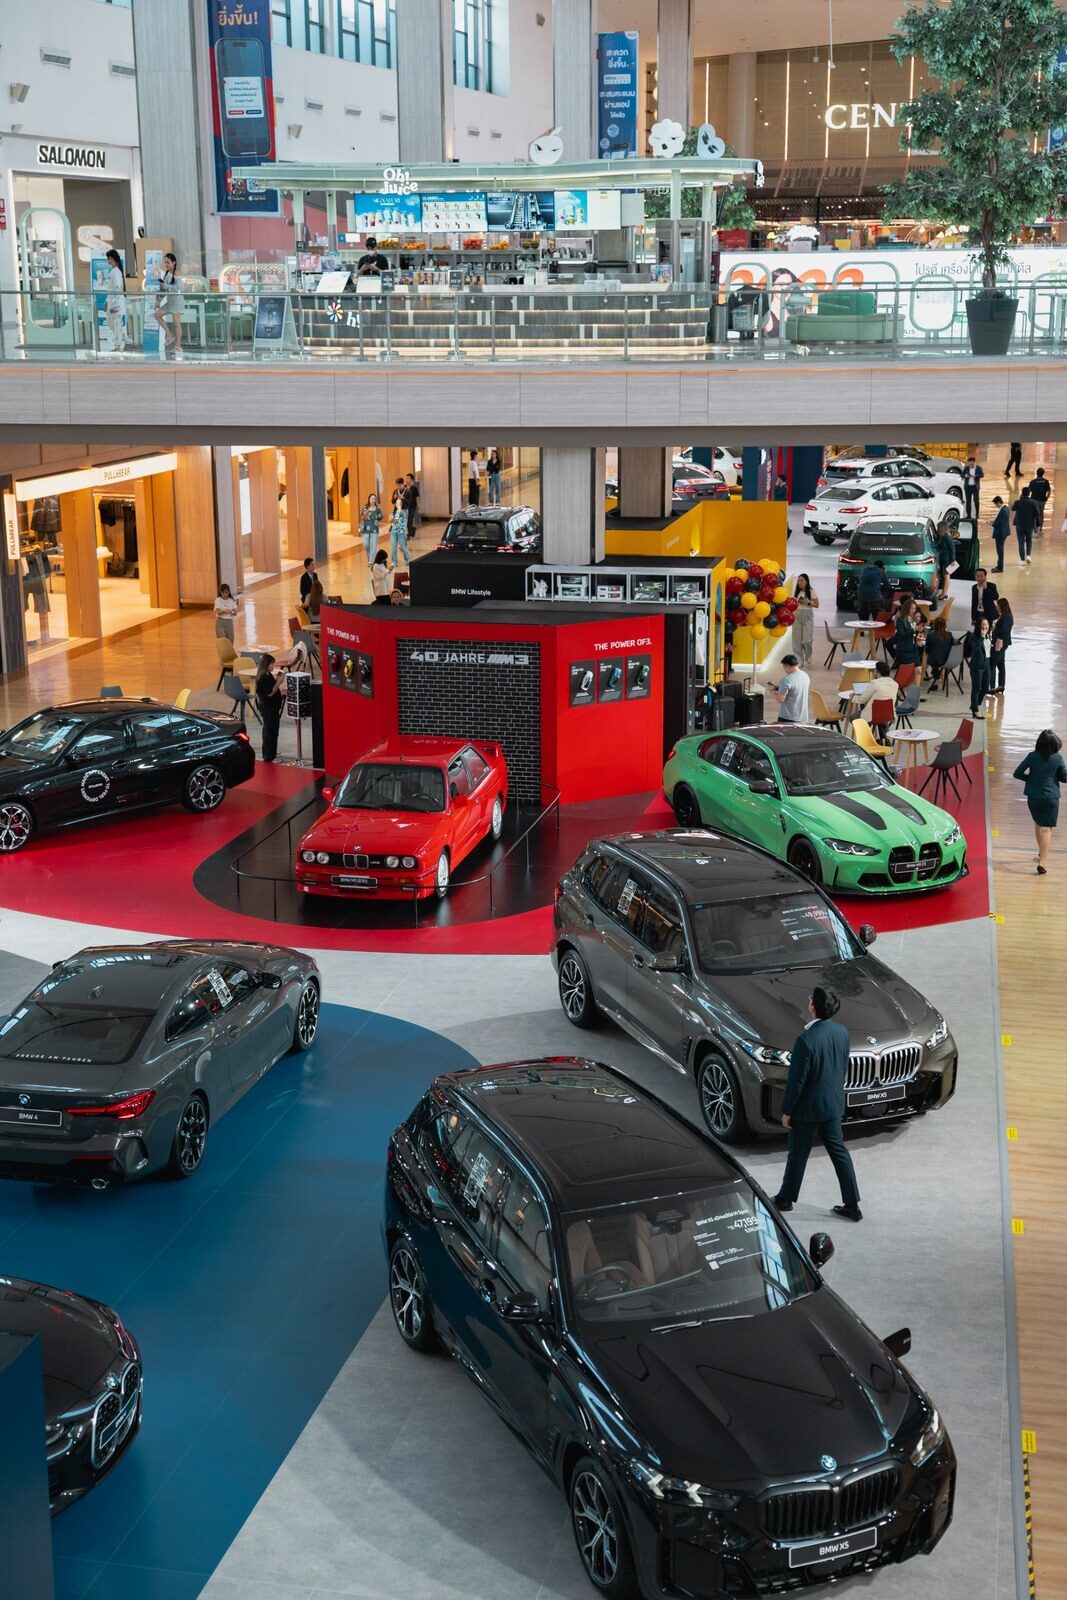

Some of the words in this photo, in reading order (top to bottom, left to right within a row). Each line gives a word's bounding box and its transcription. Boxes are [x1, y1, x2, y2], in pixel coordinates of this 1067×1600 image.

[218, 4, 258, 26] ยิ่งขึ้น!
[39, 145, 106, 169] SALOMON
[383, 167, 411, 185] Oh!
[380, 181, 419, 195] Juice
[467, 588, 492, 597] Lifestyle
[326, 627, 335, 636] THE
[335, 630, 350, 640] POWER
[594, 643, 609, 651] THE
[610, 640, 636, 649] POWER
[410, 651, 439, 662] 40
[443, 652, 486, 663] JAHRE
[819, 1544, 839, 1556] BMW
[839, 1541, 850, 1550] X5
